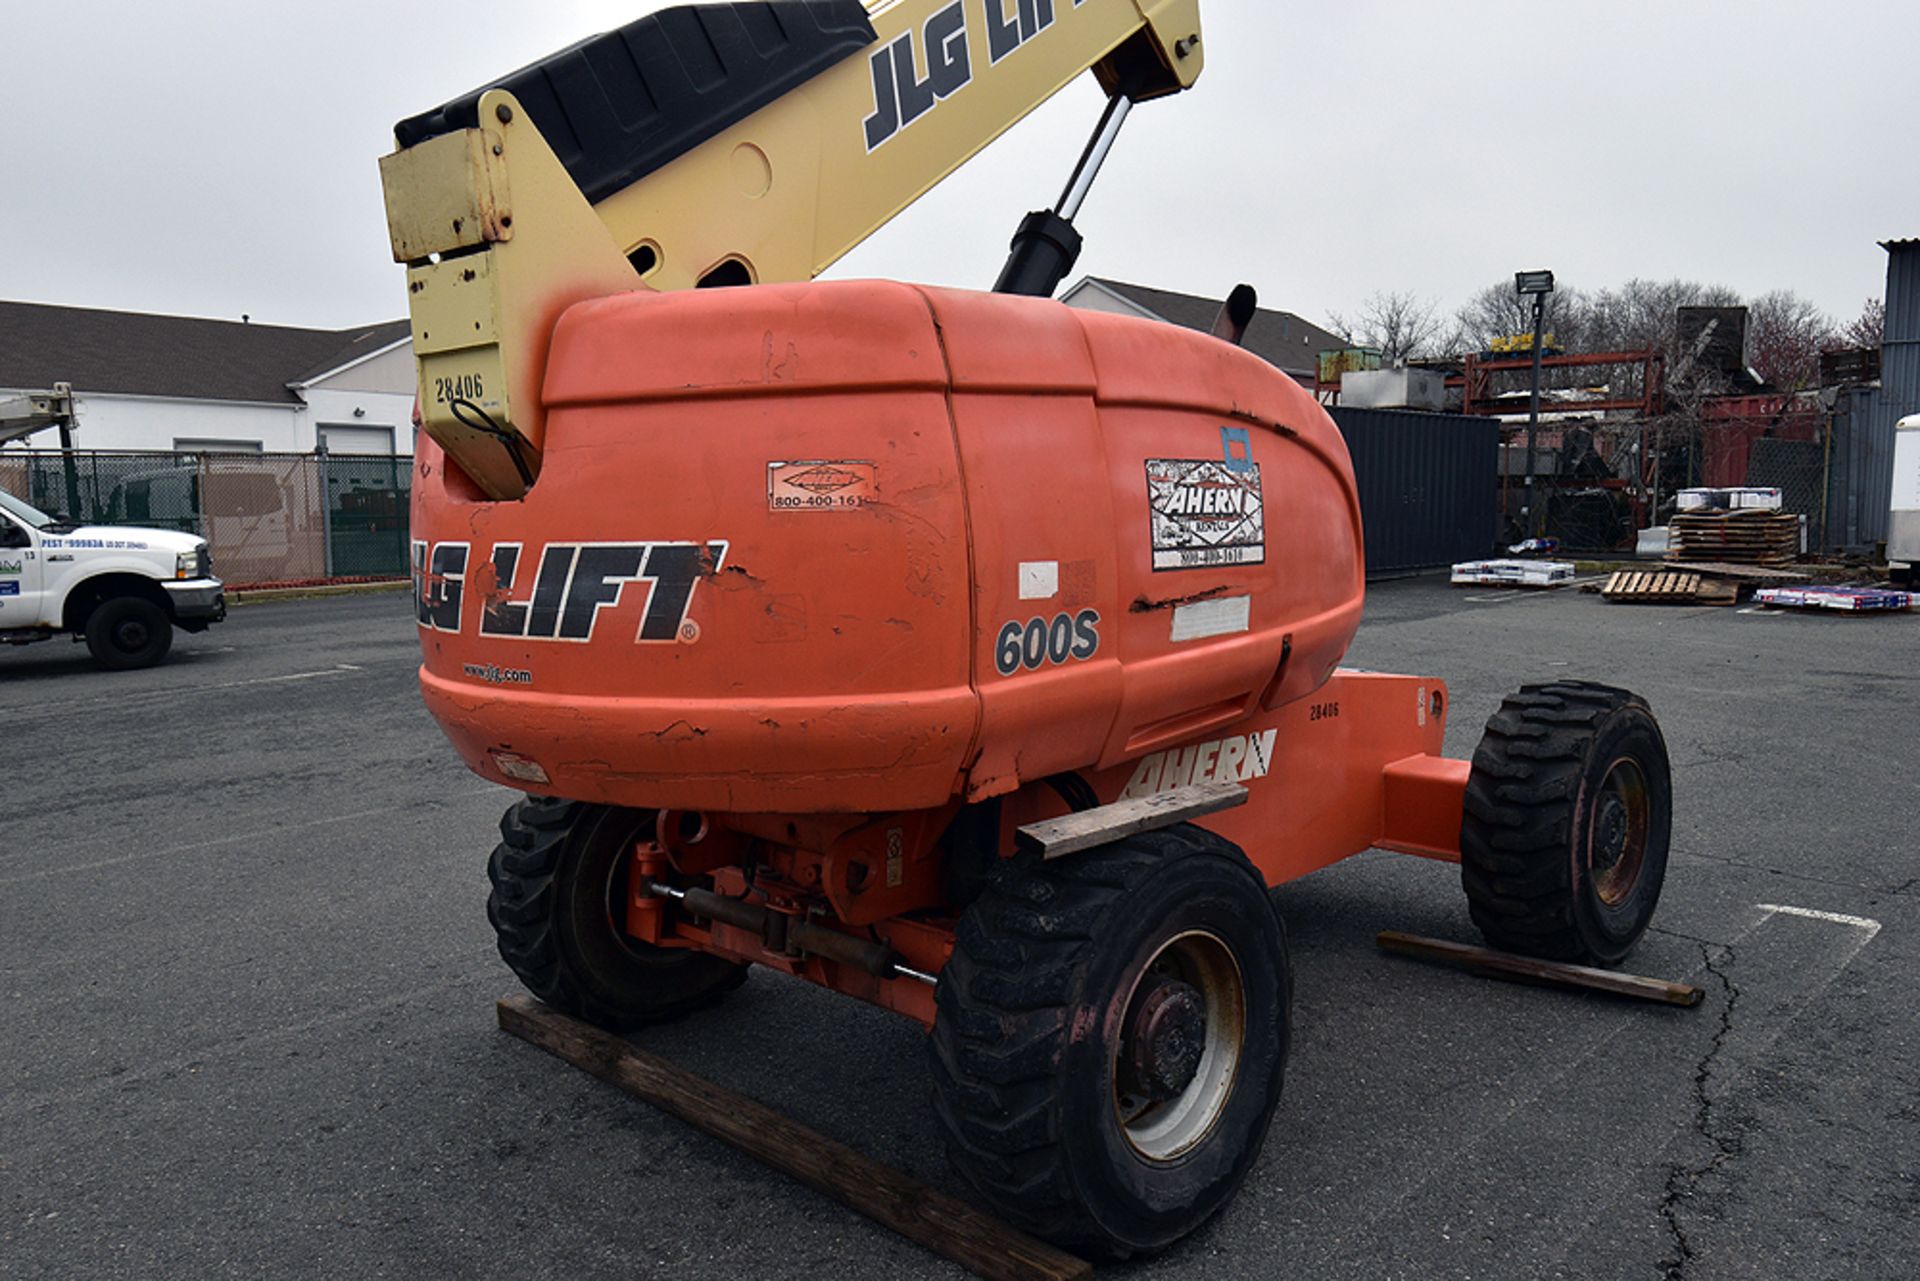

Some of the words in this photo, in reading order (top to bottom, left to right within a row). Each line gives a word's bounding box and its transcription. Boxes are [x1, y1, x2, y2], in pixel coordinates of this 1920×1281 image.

[862, 0, 974, 155] JLG
[983, 0, 1087, 67] LI
[435, 373, 483, 403] 28406
[1163, 486, 1246, 515] AHERN
[411, 541, 471, 635] LG
[479, 541, 729, 643] LIFT
[995, 607, 1100, 676] 600S
[463, 663, 533, 684] www.jlg.com
[1310, 702, 1339, 721] 28406
[1117, 728, 1278, 801] AHERN
